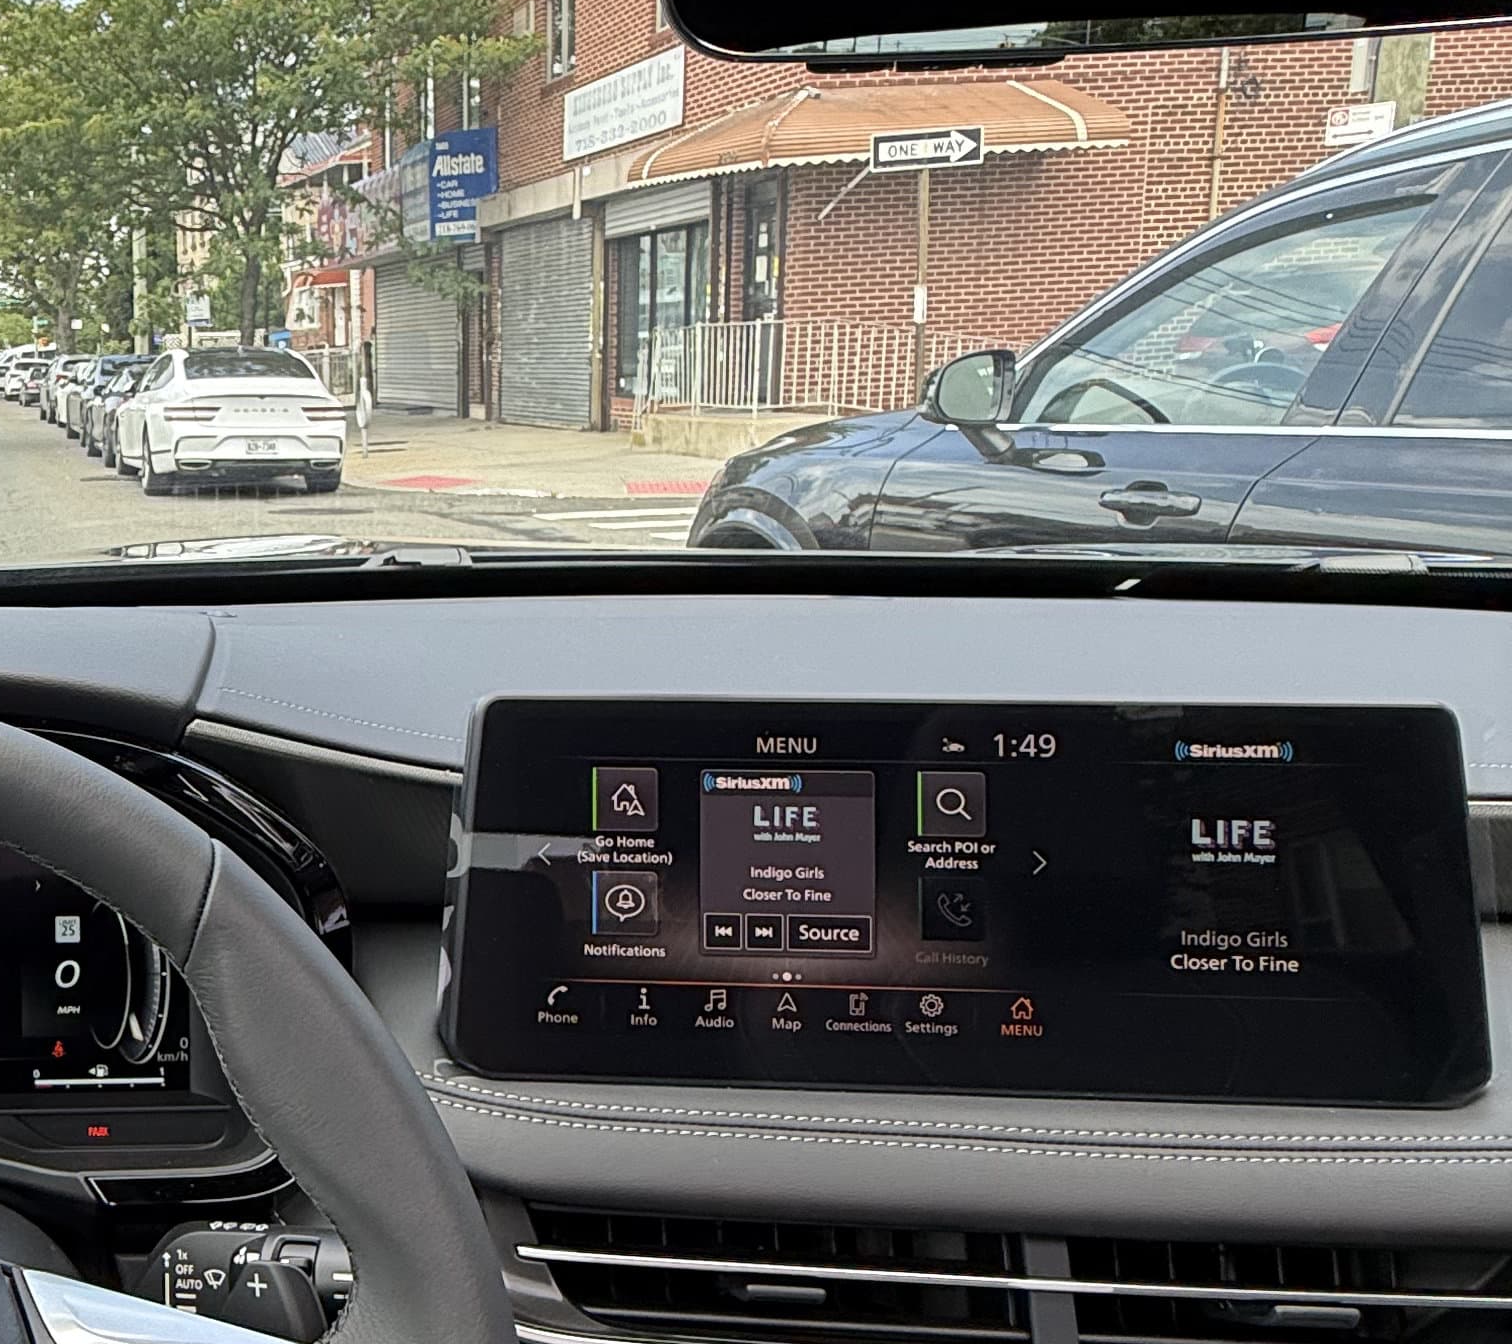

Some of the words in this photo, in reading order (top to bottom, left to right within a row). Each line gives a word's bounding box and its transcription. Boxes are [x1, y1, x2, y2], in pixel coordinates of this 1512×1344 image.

[888, 143, 919, 158] ONE
[933, 139, 965, 154] WAY
[432, 152, 485, 177] Allstate
[757, 737, 817, 753] MENU
[993, 734, 1056, 757] 1:49
[754, 806, 818, 828] LIFE
[1191, 819, 1274, 846] LIFE
[595, 835, 614, 848] Go
[617, 836, 655, 848] Home
[907, 841, 952, 853] Search
[954, 842, 978, 854] POI
[980, 844, 996, 854] or
[577, 850, 610, 864] (Save
[613, 851, 673, 865] Location)
[925, 857, 979, 869] Address
[1192, 852, 1214, 862] with
[1216, 852, 1241, 862] John
[1243, 852, 1276, 865] Mayer
[750, 866, 793, 881] Indigo
[795, 866, 825, 879] Girls
[743, 888, 782, 901] Closer
[786, 889, 801, 901] To
[804, 889, 832, 902] Fine
[61, 926, 76, 937] 25
[799, 925, 860, 941] Source
[1181, 930, 1242, 950] Indigo
[1247, 931, 1288, 948] Girls
[584, 943, 666, 957] Notifications
[915, 951, 939, 963] Call
[943, 952, 989, 967] History
[1170, 954, 1227, 971] Closer
[1232, 955, 1254, 972] To
[1259, 956, 1300, 972] Fine
[55, 960, 81, 988] 0
[57, 1006, 81, 1015] MPH
[537, 1010, 579, 1024] Phone
[630, 1013, 658, 1027] Info
[695, 1015, 735, 1029] Audio
[772, 1017, 802, 1033] Map
[825, 1019, 892, 1033] Connections
[905, 1020, 958, 1036] Settings
[1001, 1024, 1043, 1037] MENU
[179, 1037, 188, 1049] 0
[157, 1051, 189, 1062] km/h
[175, 1264, 194, 1275] OFF
[175, 1278, 204, 1291] AUTO
